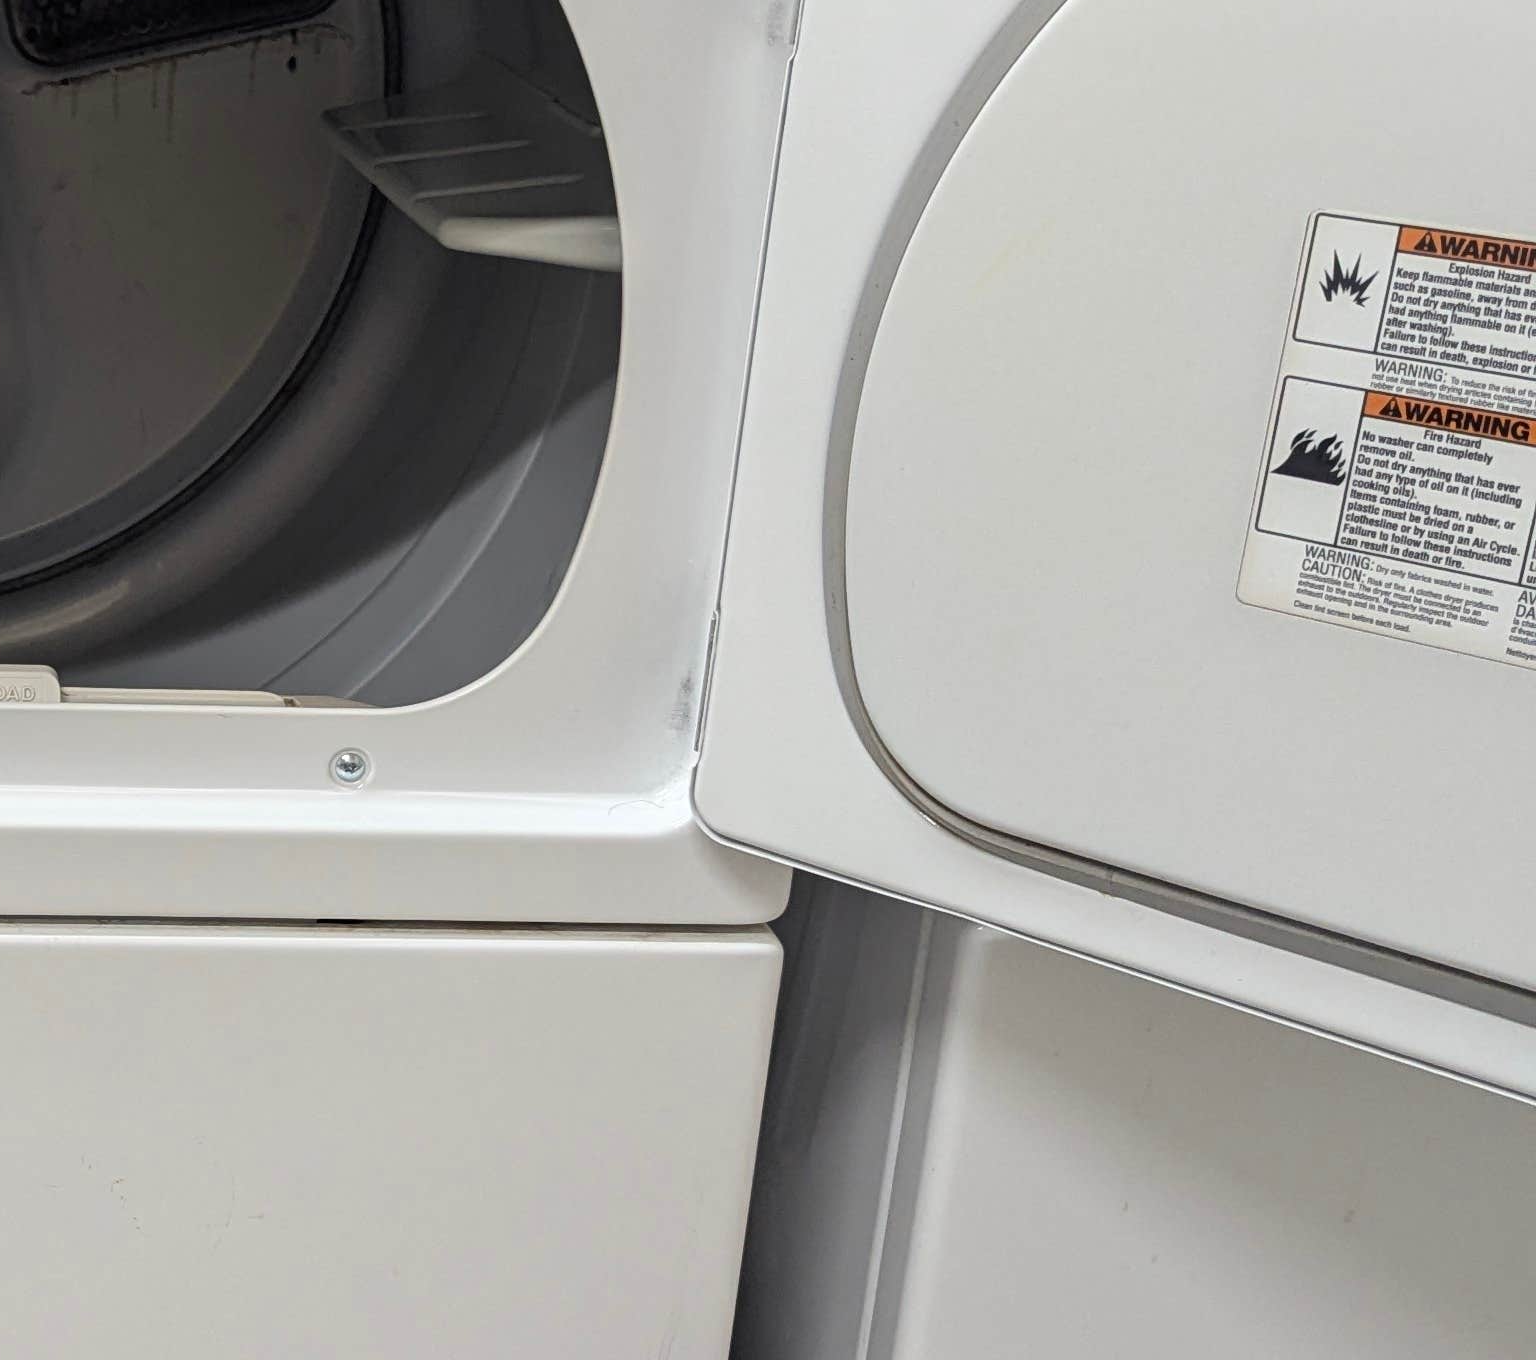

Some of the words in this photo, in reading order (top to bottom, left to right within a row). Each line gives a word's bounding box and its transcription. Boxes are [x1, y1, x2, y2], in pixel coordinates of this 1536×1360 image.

[1448, 262, 1496, 279] Explosion
[1497, 269, 1532, 285] Hazard
[1375, 357, 1448, 383] WARNING:
[1405, 400, 1531, 443] WARNING
[1359, 444, 1397, 458] remove
[1398, 450, 1415, 462] oil.
[1361, 431, 1376, 442] No
[1378, 435, 1415, 450] washer
[1415, 442, 1435, 453] can
[1436, 446, 1494, 466] completely
[1423, 429, 1444, 443] Fire
[1445, 433, 1482, 450] Hazard
[1351, 479, 1391, 496] cooking
[1392, 486, 1417, 501] oils).
[1354, 465, 1374, 478] had
[1374, 471, 1394, 484] any
[1395, 473, 1417, 487] type
[1418, 479, 1430, 489] of
[1430, 481, 1445, 492] oil
[1446, 485, 1460, 495] on
[1461, 486, 1470, 497] it
[1470, 488, 1523, 509] (including
[1356, 454, 1372, 466] Do
[1372, 458, 1390, 469] not
[1391, 461, 1408, 474] dry
[1408, 465, 1453, 483] anything
[1454, 472, 1475, 486] that
[1475, 476, 1495, 490] has
[1496, 482, 1521, 494] ever
[1346, 501, 1381, 516] plastic
[1381, 508, 1407, 521] must
[1408, 512, 1422, 524] be
[1423, 516, 1451, 530] dried
[1451, 522, 1466, 533] on
[1466, 525, 1474, 535] a
[1349, 488, 1378, 503] Items
[1379, 496, 1432, 516] containing
[1432, 505, 1462, 521] foam,
[1464, 513, 1501, 529] rubber,
[1503, 520, 1516, 531] or
[1342, 522, 1377, 539] Failure
[1379, 530, 1389, 542] to
[1390, 532, 1422, 548] follow
[1423, 539, 1451, 554] these
[1453, 545, 1513, 567] instructions
[1345, 512, 1399, 532] clothesline
[1400, 524, 1412, 534] or
[1412, 525, 1426, 539] by
[1426, 530, 1455, 545] using
[1456, 536, 1471, 546] an
[1471, 537, 1488, 549] Air
[1489, 541, 1521, 557] Cycle.
[1305, 544, 1375, 572] WARNING:
[1340, 536, 1359, 547] can
[1359, 540, 1389, 554] result
[1389, 544, 1400, 556] in
[1401, 547, 1430, 562] death
[1431, 555, 1444, 565] or
[1444, 556, 1465, 570] fire.
[1301, 558, 1366, 584] CAUTION:
